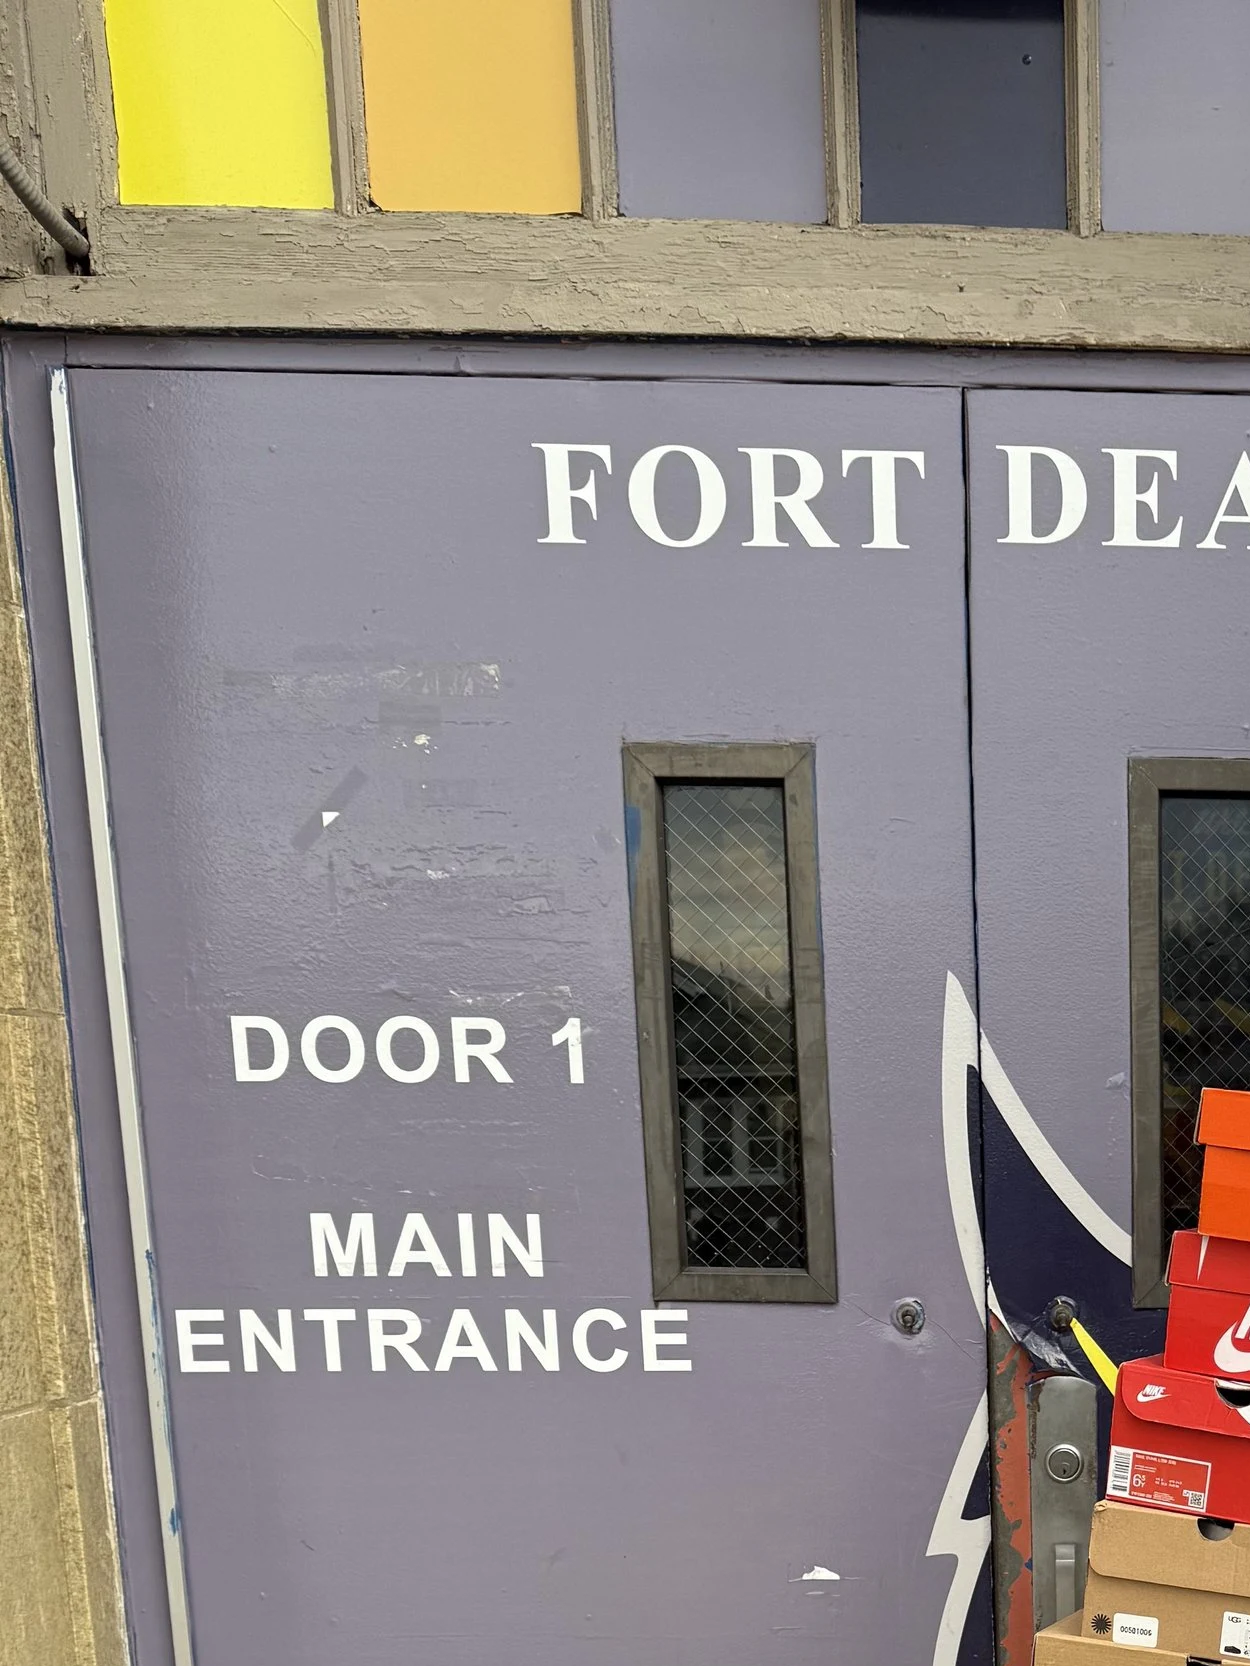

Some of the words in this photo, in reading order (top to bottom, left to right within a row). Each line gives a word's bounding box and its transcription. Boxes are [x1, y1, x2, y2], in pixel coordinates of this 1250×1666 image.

[531, 442, 925, 548] FORT
[229, 1014, 514, 1084] DOOR
[551, 1017, 585, 1085] 1
[309, 1212, 545, 1278] MAIN
[174, 1308, 693, 1373] ENTRANCE
[1228, 1616, 1242, 1624] UGG
